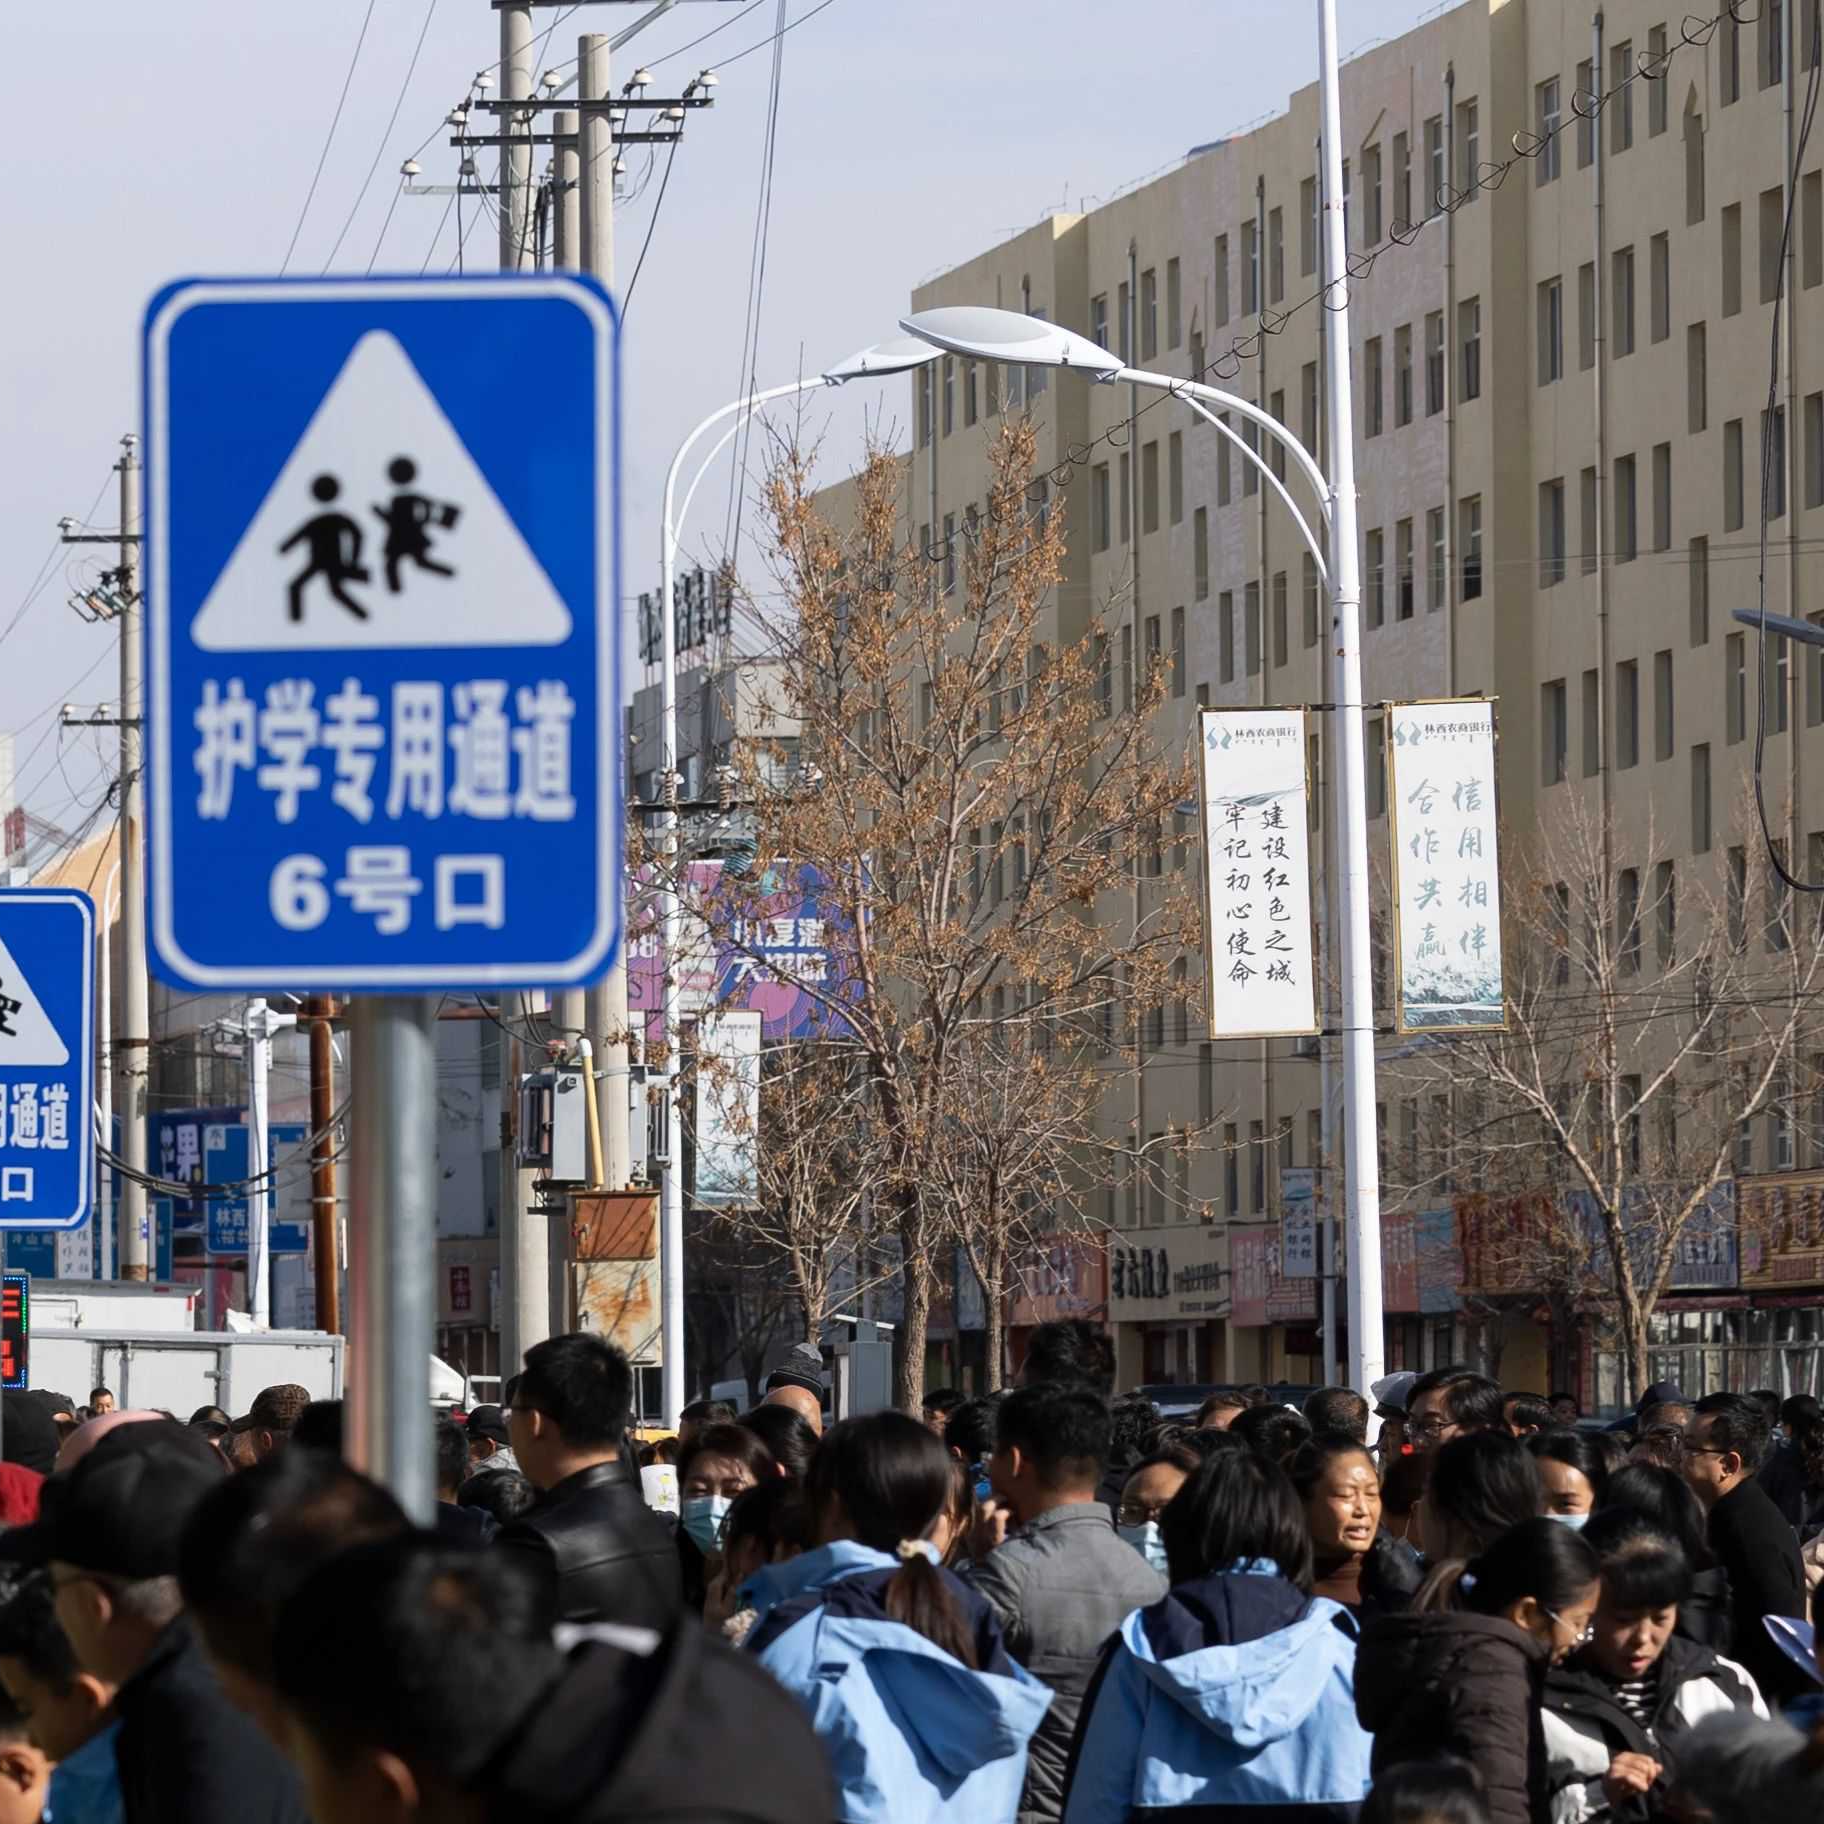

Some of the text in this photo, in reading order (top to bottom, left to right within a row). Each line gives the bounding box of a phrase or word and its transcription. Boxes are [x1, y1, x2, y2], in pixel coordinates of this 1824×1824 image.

[195, 678, 576, 822] 护学专用通道
[1235, 728, 1297, 742] 林西农商银行
[1425, 721, 1493, 735] 林西农商银行
[270, 845, 506, 937] 6号口
[1224, 803, 1258, 989] 牢记初心使命
[1261, 802, 1296, 986] 建设红色之城
[1407, 779, 1446, 961] 合作共赢
[1452, 777, 1490, 961] 信用相伴
